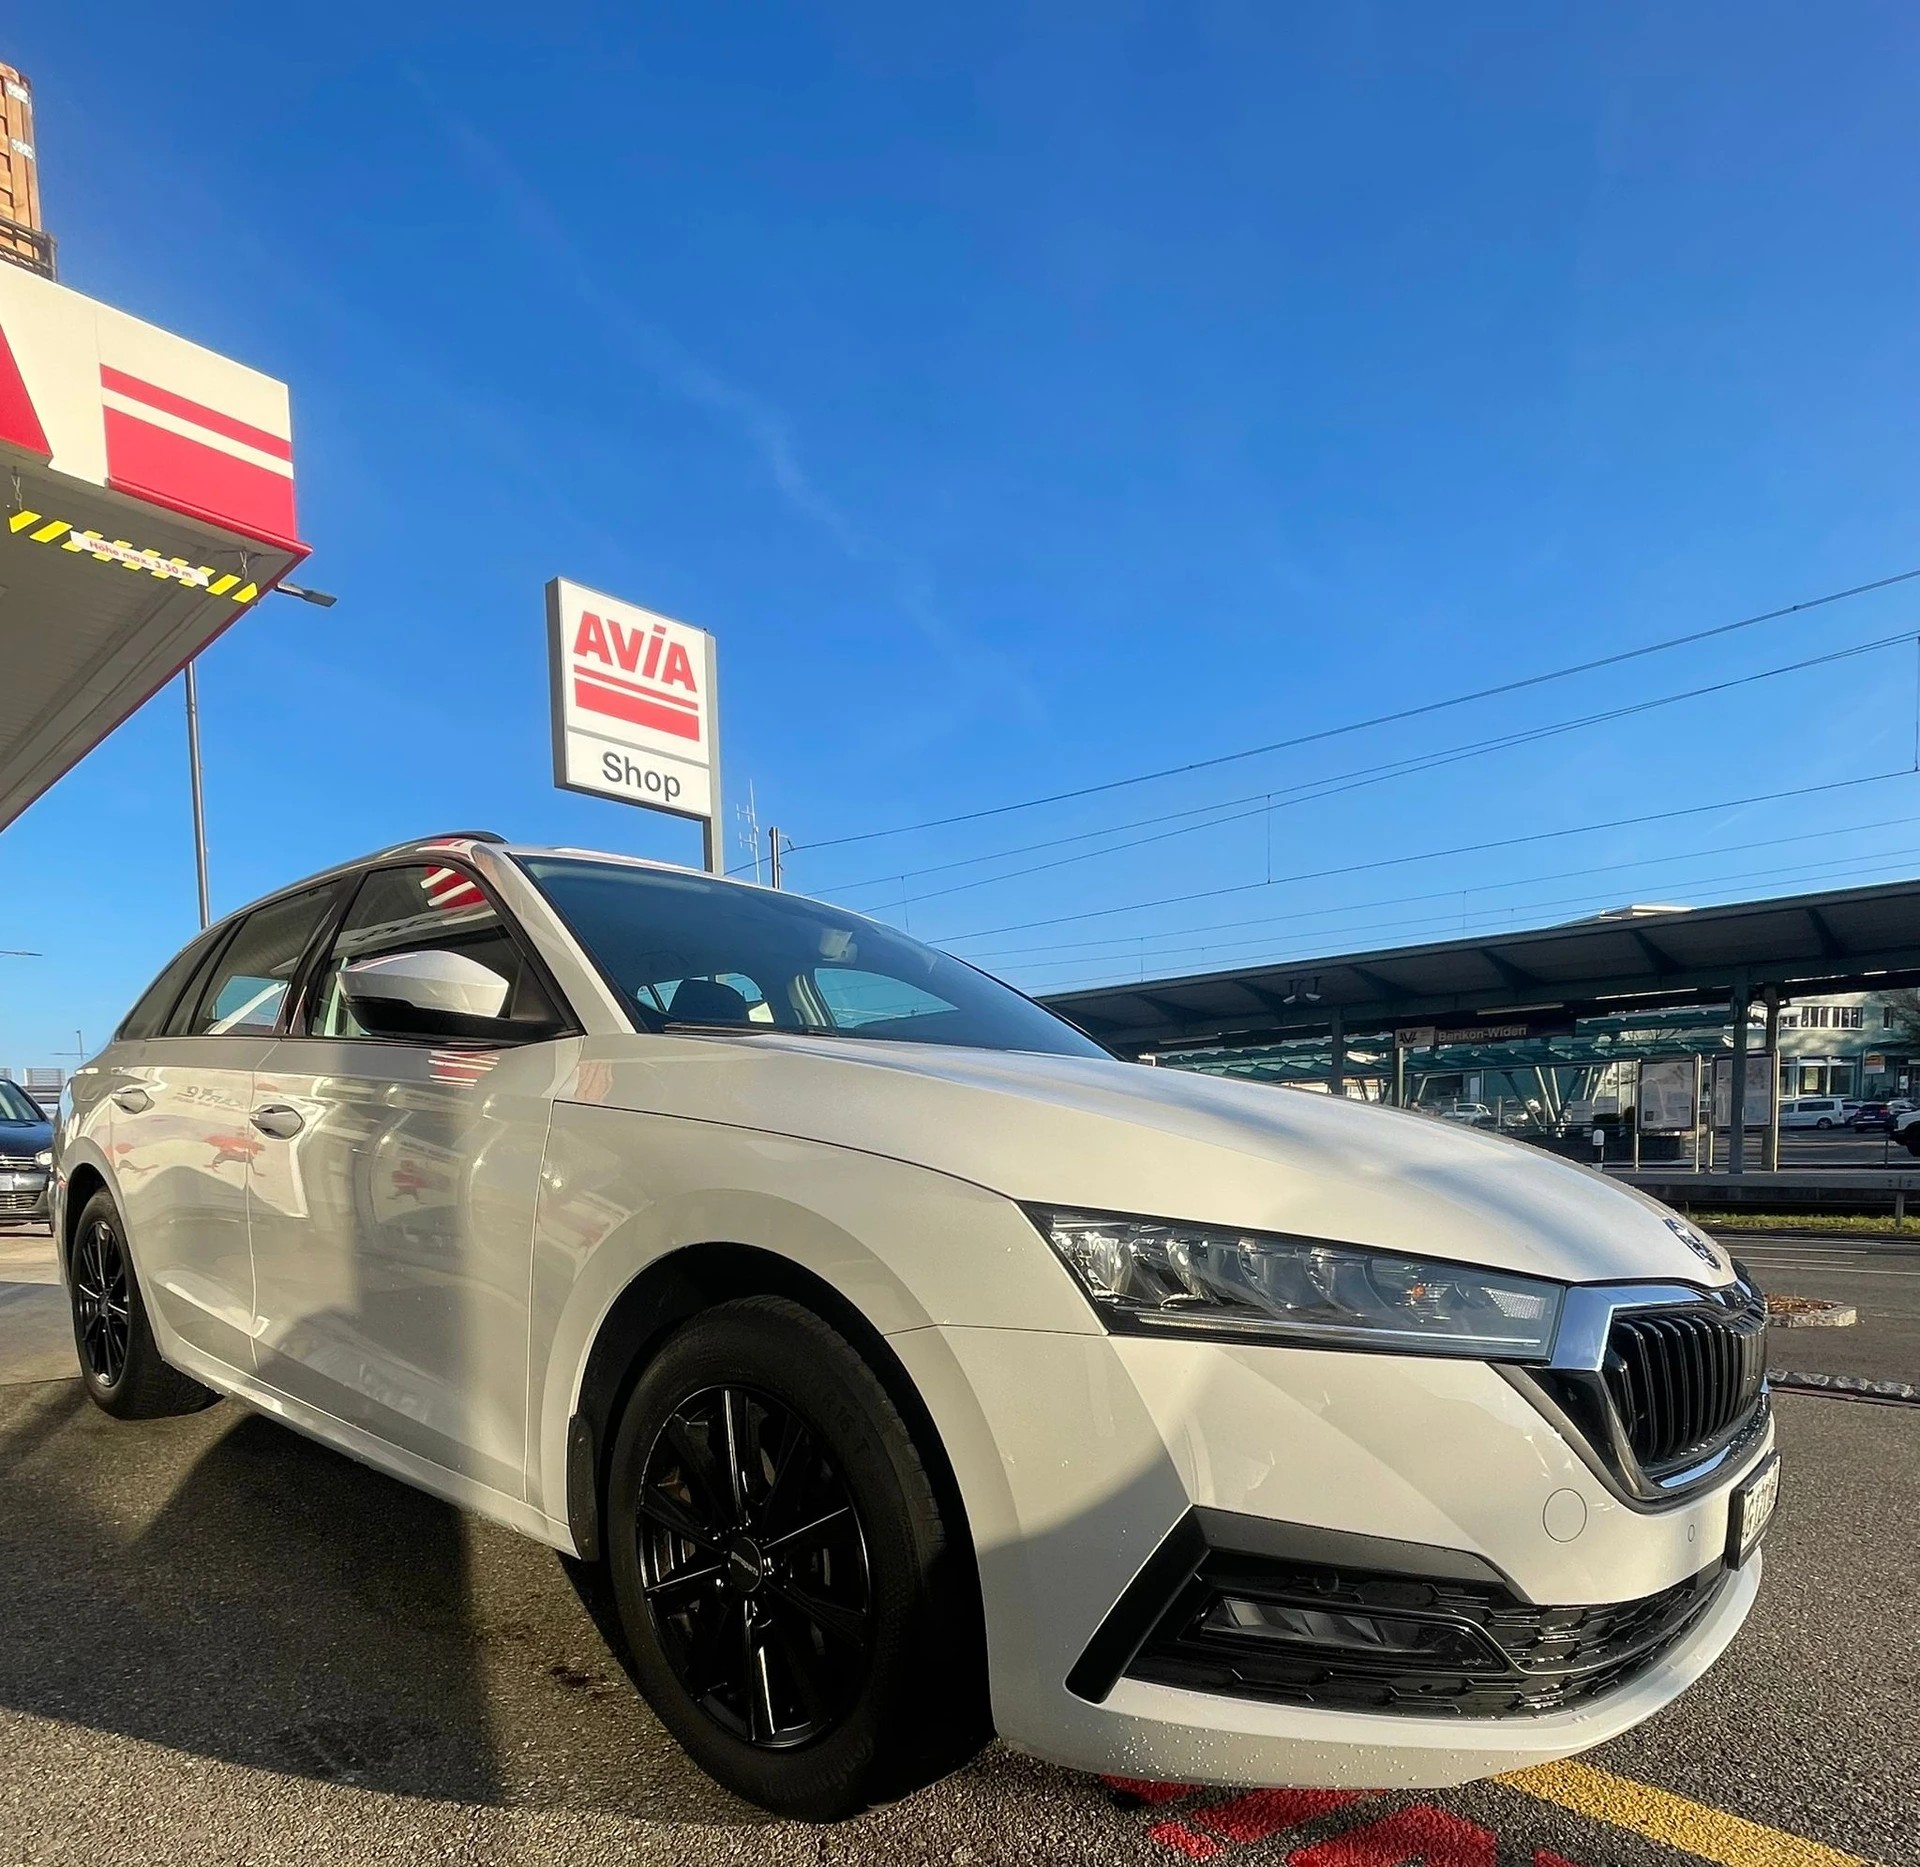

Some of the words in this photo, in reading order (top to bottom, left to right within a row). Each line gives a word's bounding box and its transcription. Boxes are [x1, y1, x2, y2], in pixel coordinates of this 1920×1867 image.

[182, 570, 193, 578] m
[602, 751, 681, 802] Shop
[1438, 1026, 1527, 1042] Berikon-Widen
